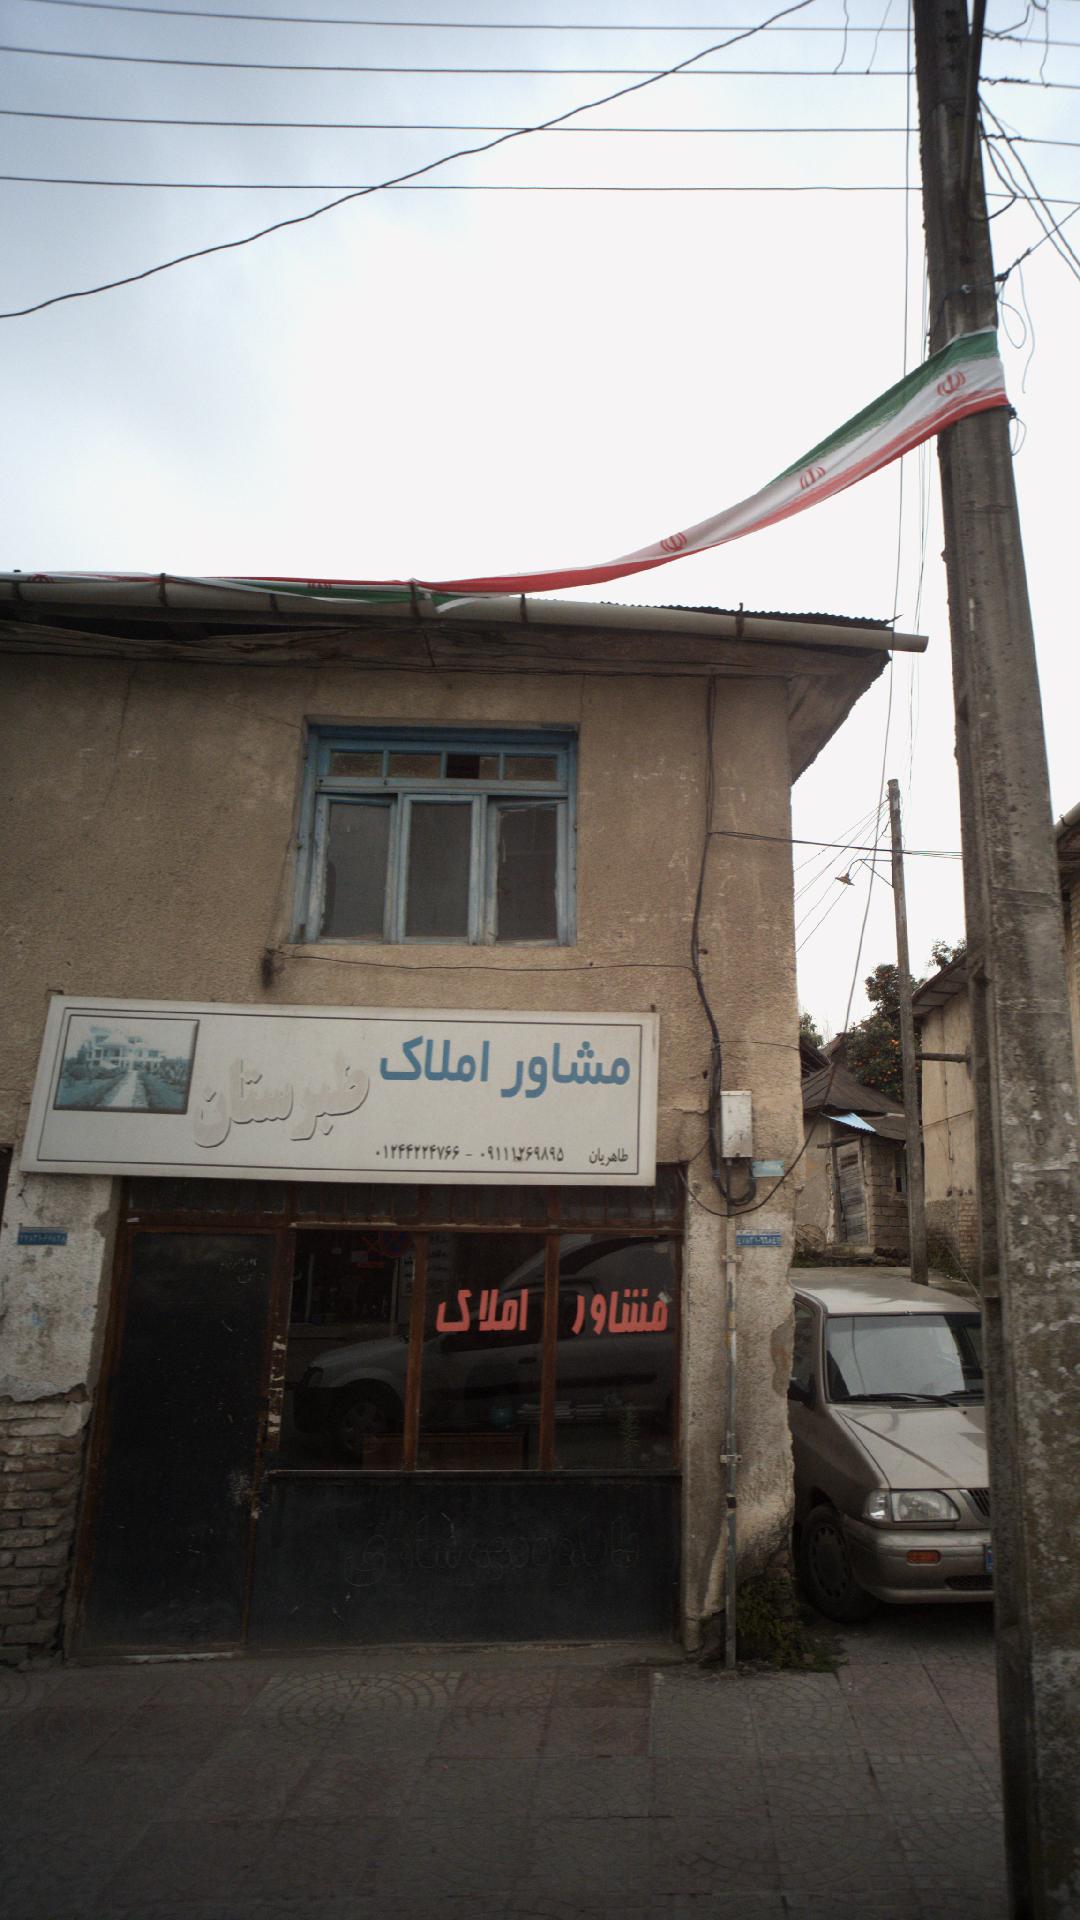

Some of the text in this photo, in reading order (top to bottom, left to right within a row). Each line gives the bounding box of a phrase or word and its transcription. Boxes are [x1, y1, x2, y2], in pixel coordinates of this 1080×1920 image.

[380, 1036, 490, 1083] املاک
[500, 1040, 630, 1098] مشاور
[588, 1148, 629, 1167] طاهریان
[436, 1288, 669, 1334] مشاور املاک
